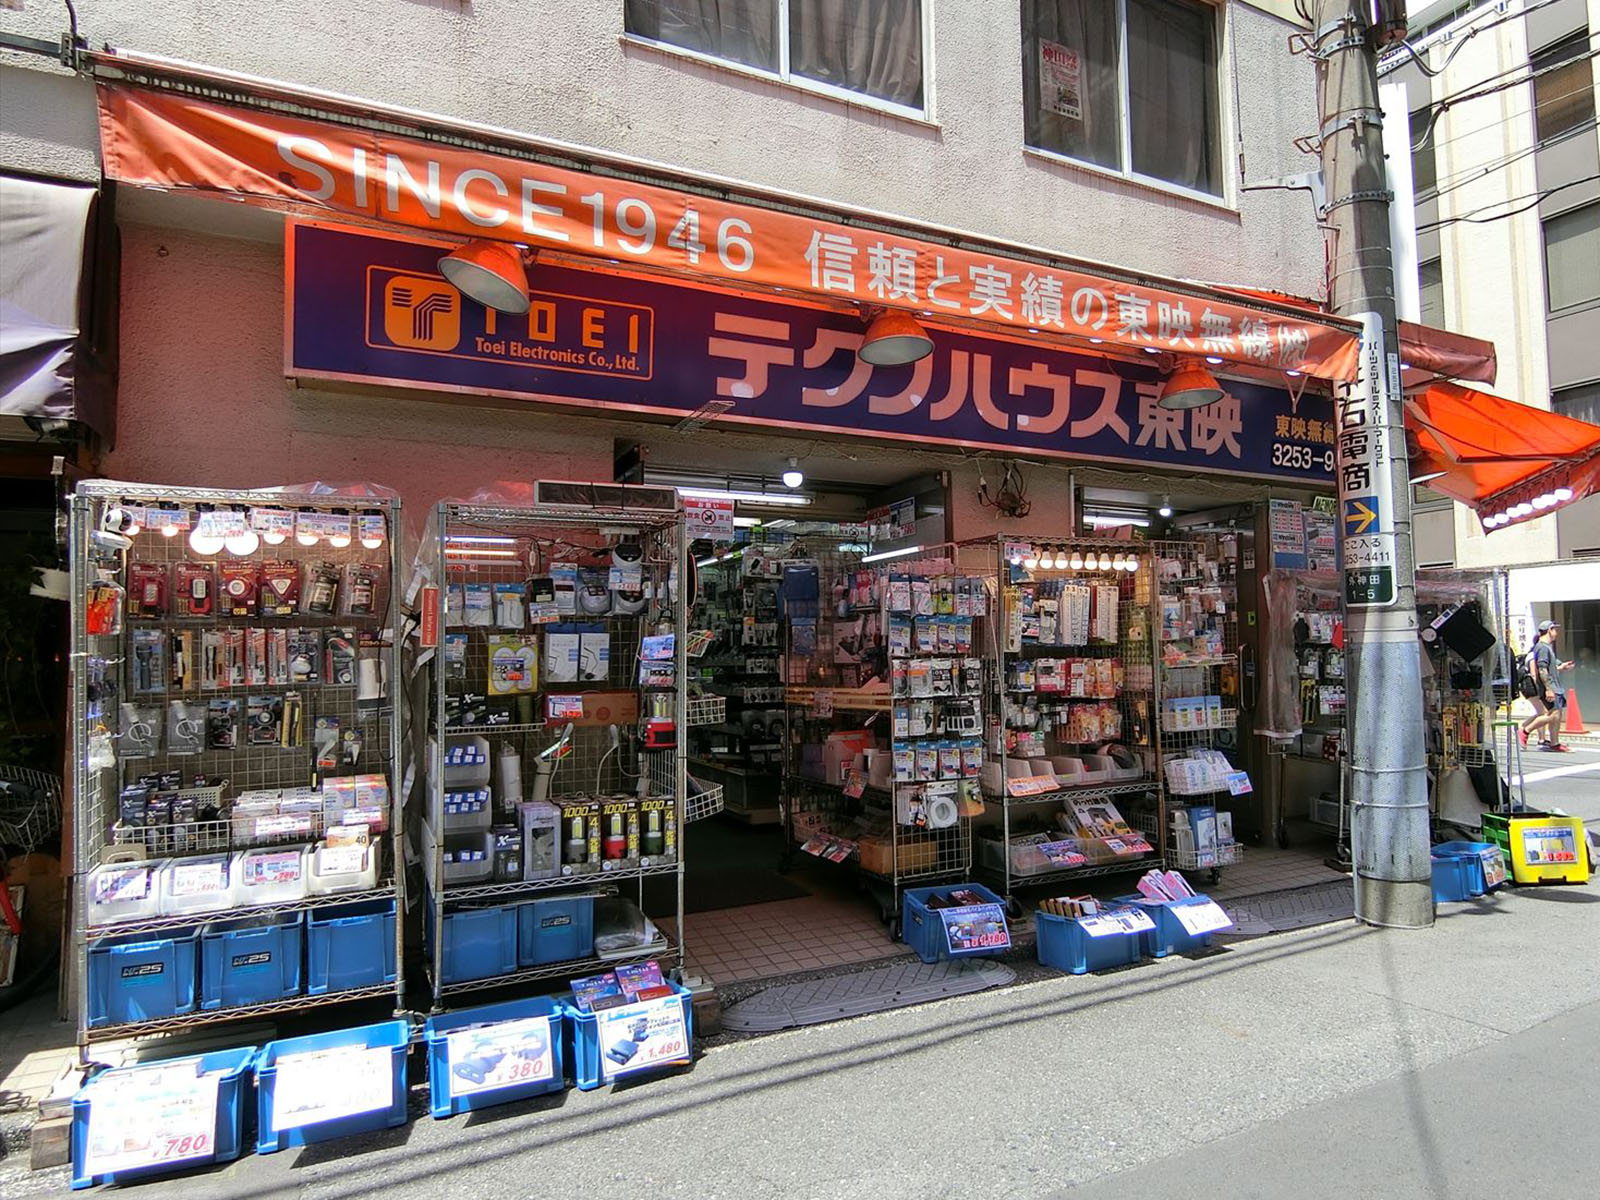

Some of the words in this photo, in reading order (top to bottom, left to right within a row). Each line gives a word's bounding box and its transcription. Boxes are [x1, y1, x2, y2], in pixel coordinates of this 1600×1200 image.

[475, 336, 505, 356] Toei
[509, 341, 585, 365] Electronics
[1272, 443, 1336, 472] 3253-9
[603, 803, 627, 815] 1000
[641, 800, 665, 811] 1000
[563, 806, 589, 818] 1000
